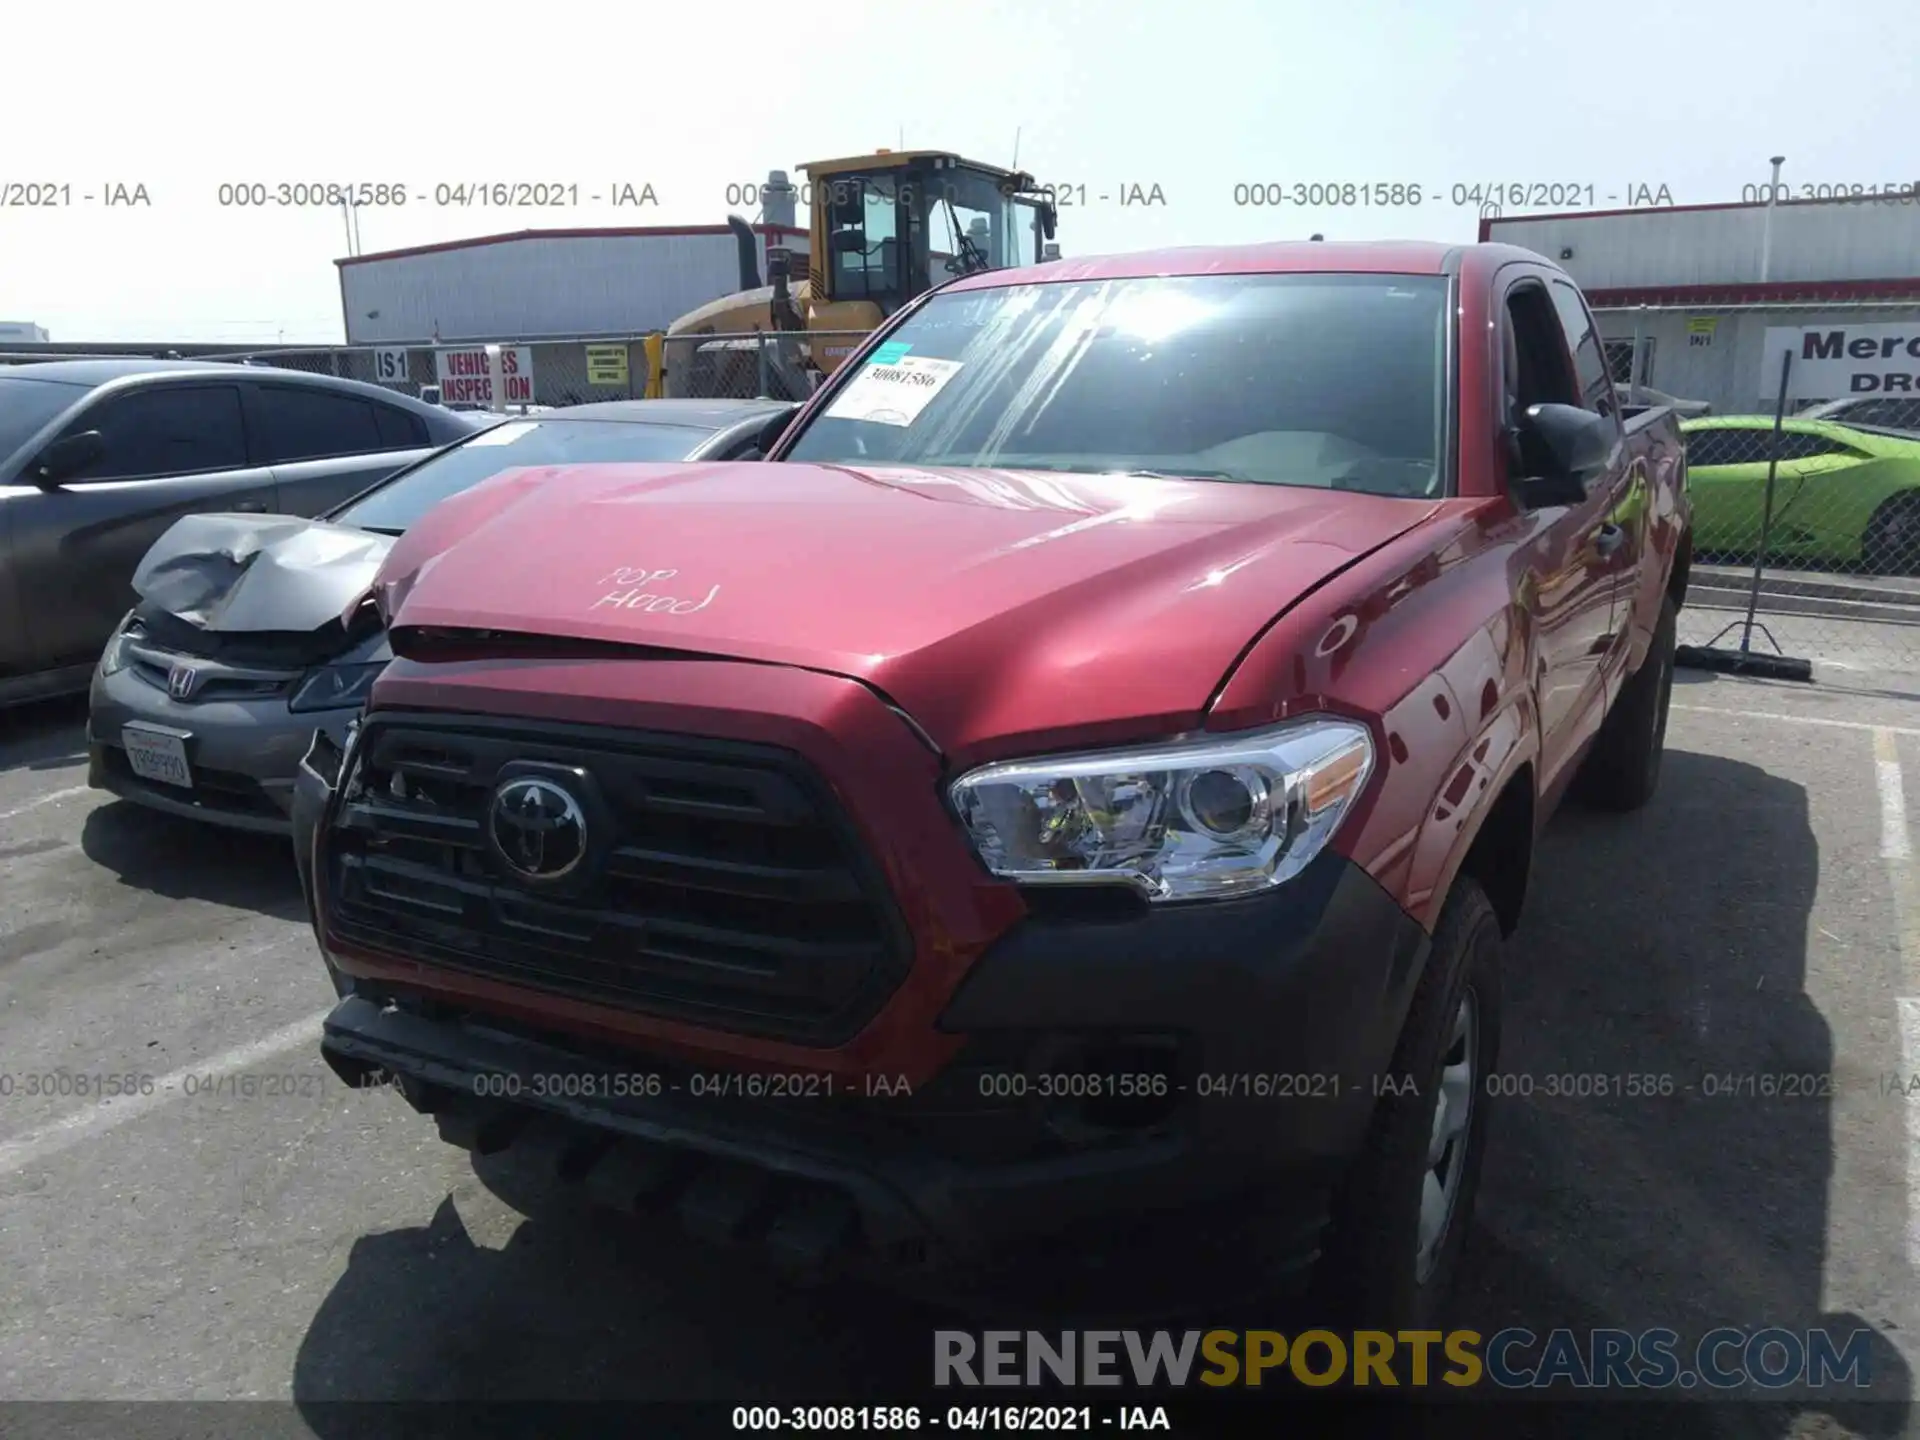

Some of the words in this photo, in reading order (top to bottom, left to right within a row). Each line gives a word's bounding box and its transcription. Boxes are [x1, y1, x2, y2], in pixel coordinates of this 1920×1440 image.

[446, 351, 518, 376] VEHICES
[441, 377, 530, 402] INSPECION
[872, 367, 936, 387] 30081586
